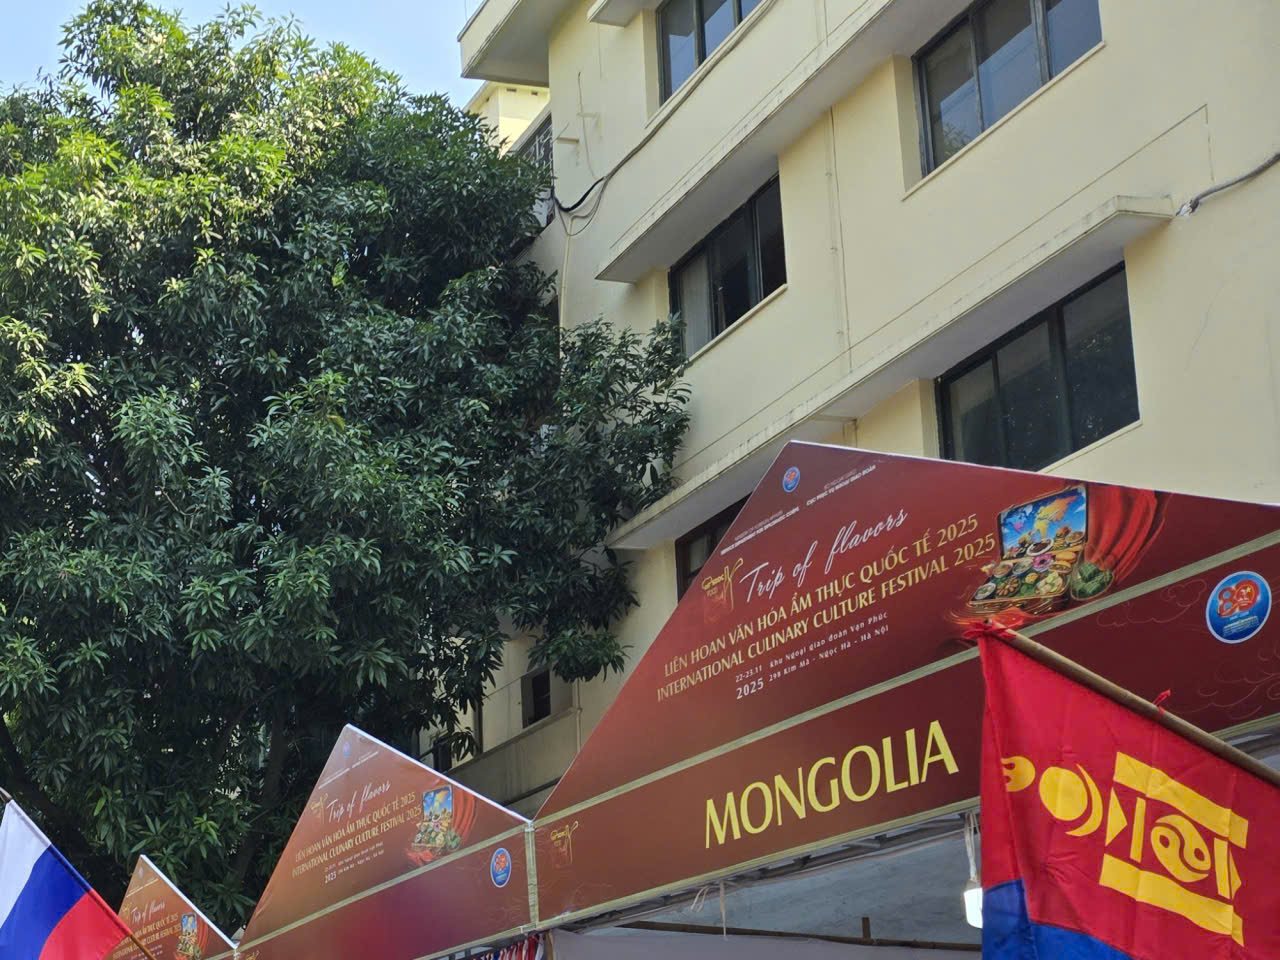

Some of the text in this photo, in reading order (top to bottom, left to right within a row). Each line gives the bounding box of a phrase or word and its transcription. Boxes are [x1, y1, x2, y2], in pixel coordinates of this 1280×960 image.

[656, 533, 996, 702] INTERNATIONAL CULINARY CULTURE FESTIVAL 2025
[664, 651, 688, 678] LIÊN
[690, 635, 726, 664] HOAN
[728, 621, 754, 646] VĂN
[757, 606, 787, 632] HÓA
[815, 572, 856, 602] THỰC
[859, 546, 910, 583] QUỐC
[912, 528, 932, 557] TẾ
[936, 513, 979, 547] 2025
[739, 561, 785, 603] Trip
[792, 540, 818, 588] of
[824, 508, 908, 575] flavors
[736, 677, 764, 700] 2025
[705, 720, 960, 849] MONGOLIA
